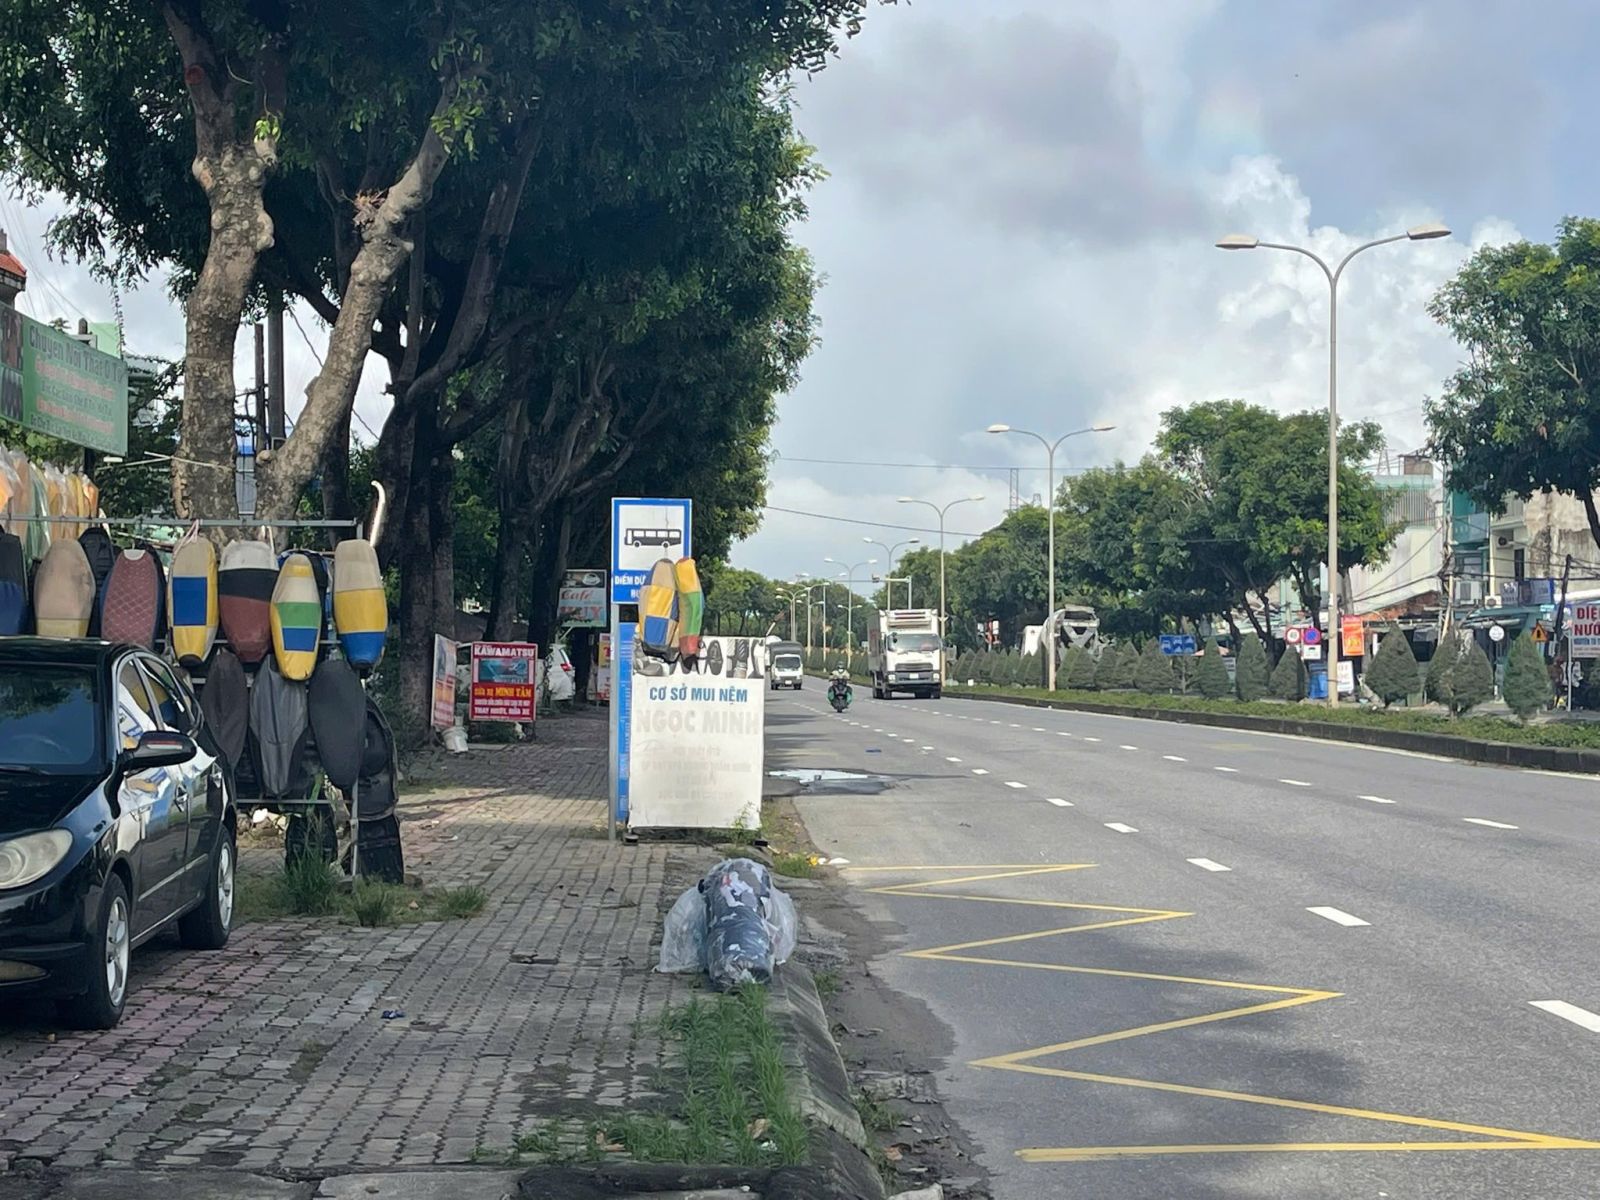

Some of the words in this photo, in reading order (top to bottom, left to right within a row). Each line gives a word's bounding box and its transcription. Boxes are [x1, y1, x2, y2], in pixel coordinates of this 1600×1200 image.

[634, 574, 647, 585] DỪ
[1574, 620, 1600, 635] NƯỚ
[474, 646, 535, 657] KAWAMATSU
[649, 686, 667, 701] CƠ
[670, 683, 688, 701] SỞ
[691, 687, 715, 702] MUI
[636, 710, 696, 738] NGỌC
[702, 710, 759, 735] MINH
